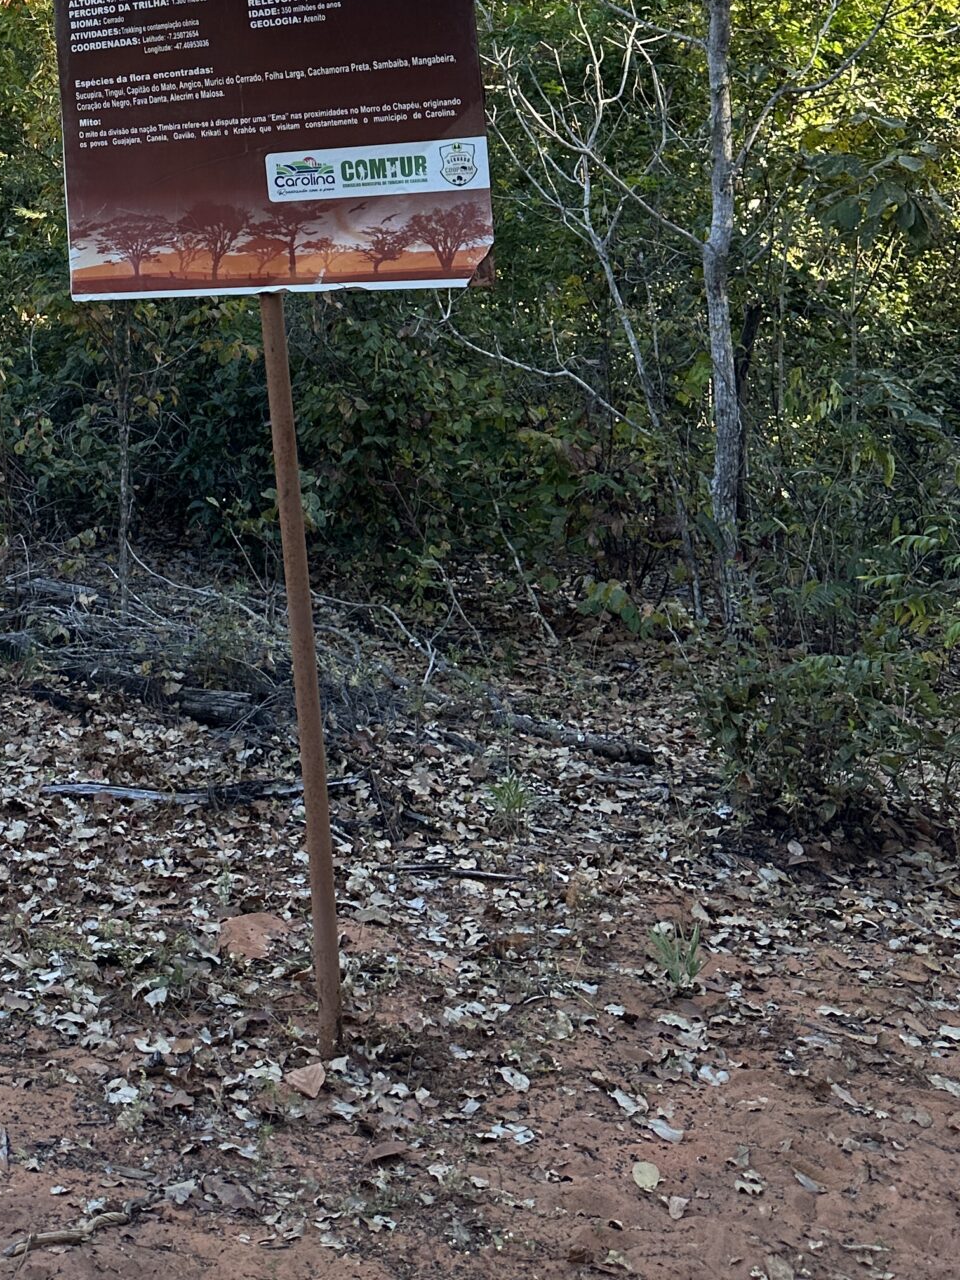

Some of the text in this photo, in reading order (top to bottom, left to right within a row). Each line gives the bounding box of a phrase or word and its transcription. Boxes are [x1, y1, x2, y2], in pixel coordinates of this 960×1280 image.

[69, 6, 115, 19] PERCURSO
[118, 4, 130, 12] DA
[248, 7, 280, 18] IDADE:
[293, 3, 316, 12] milhões
[70, 16, 124, 29] BIOMA: Cerrado
[147, 20, 181, 31] contemplação
[250, 14, 326, 29] GEOLOGIA: Arenito
[71, 37, 140, 52] COORDENADAS:
[75, 77, 114, 88] Espécies
[130, 74, 151, 82] flora
[153, 67, 214, 80] encontradas:
[76, 91, 104, 100] Sucupira,
[105, 89, 125, 98] Tingui,
[127, 84, 150, 95] Capitão
[161, 83, 178, 91] Mato,
[180, 80, 203, 90] Angico,
[204, 78, 224, 87] Murici
[226, 76, 234, 84] do
[236, 74, 264, 83] Cerrado,
[265, 71, 284, 80] Folha
[285, 70, 306, 80] Larga,
[308, 66, 349, 76] Cachamorra
[351, 63, 371, 72] Preta,
[412, 54, 456, 66] Mangabeira,
[77, 102, 102, 111] Coração
[112, 99, 132, 109] Negro,
[170, 92, 194, 102] Alecrim
[79, 119, 101, 127] Mito:
[108, 128, 129, 136] divisão
[139, 125, 157, 134] nação
[158, 122, 181, 131] Timbira
[216, 118, 238, 128] disputa
[304, 108, 348, 120] proximidades
[360, 105, 380, 113] Morro
[393, 102, 421, 110] Chapéu,
[423, 97, 461, 109] originando
[90, 140, 108, 149] povos
[112, 136, 142, 147] Guajajara,
[147, 134, 169, 143] Canela,
[173, 131, 196, 140] Gavião,
[201, 129, 221, 137] Krikati
[259, 125, 271, 134] que
[277, 123, 300, 131] visitam
[305, 117, 358, 128] constantemente
[374, 112, 407, 122] município
[426, 109, 457, 118] Carolina.
[341, 155, 427, 181] COMTUR
[274, 174, 335, 188] Carolina
